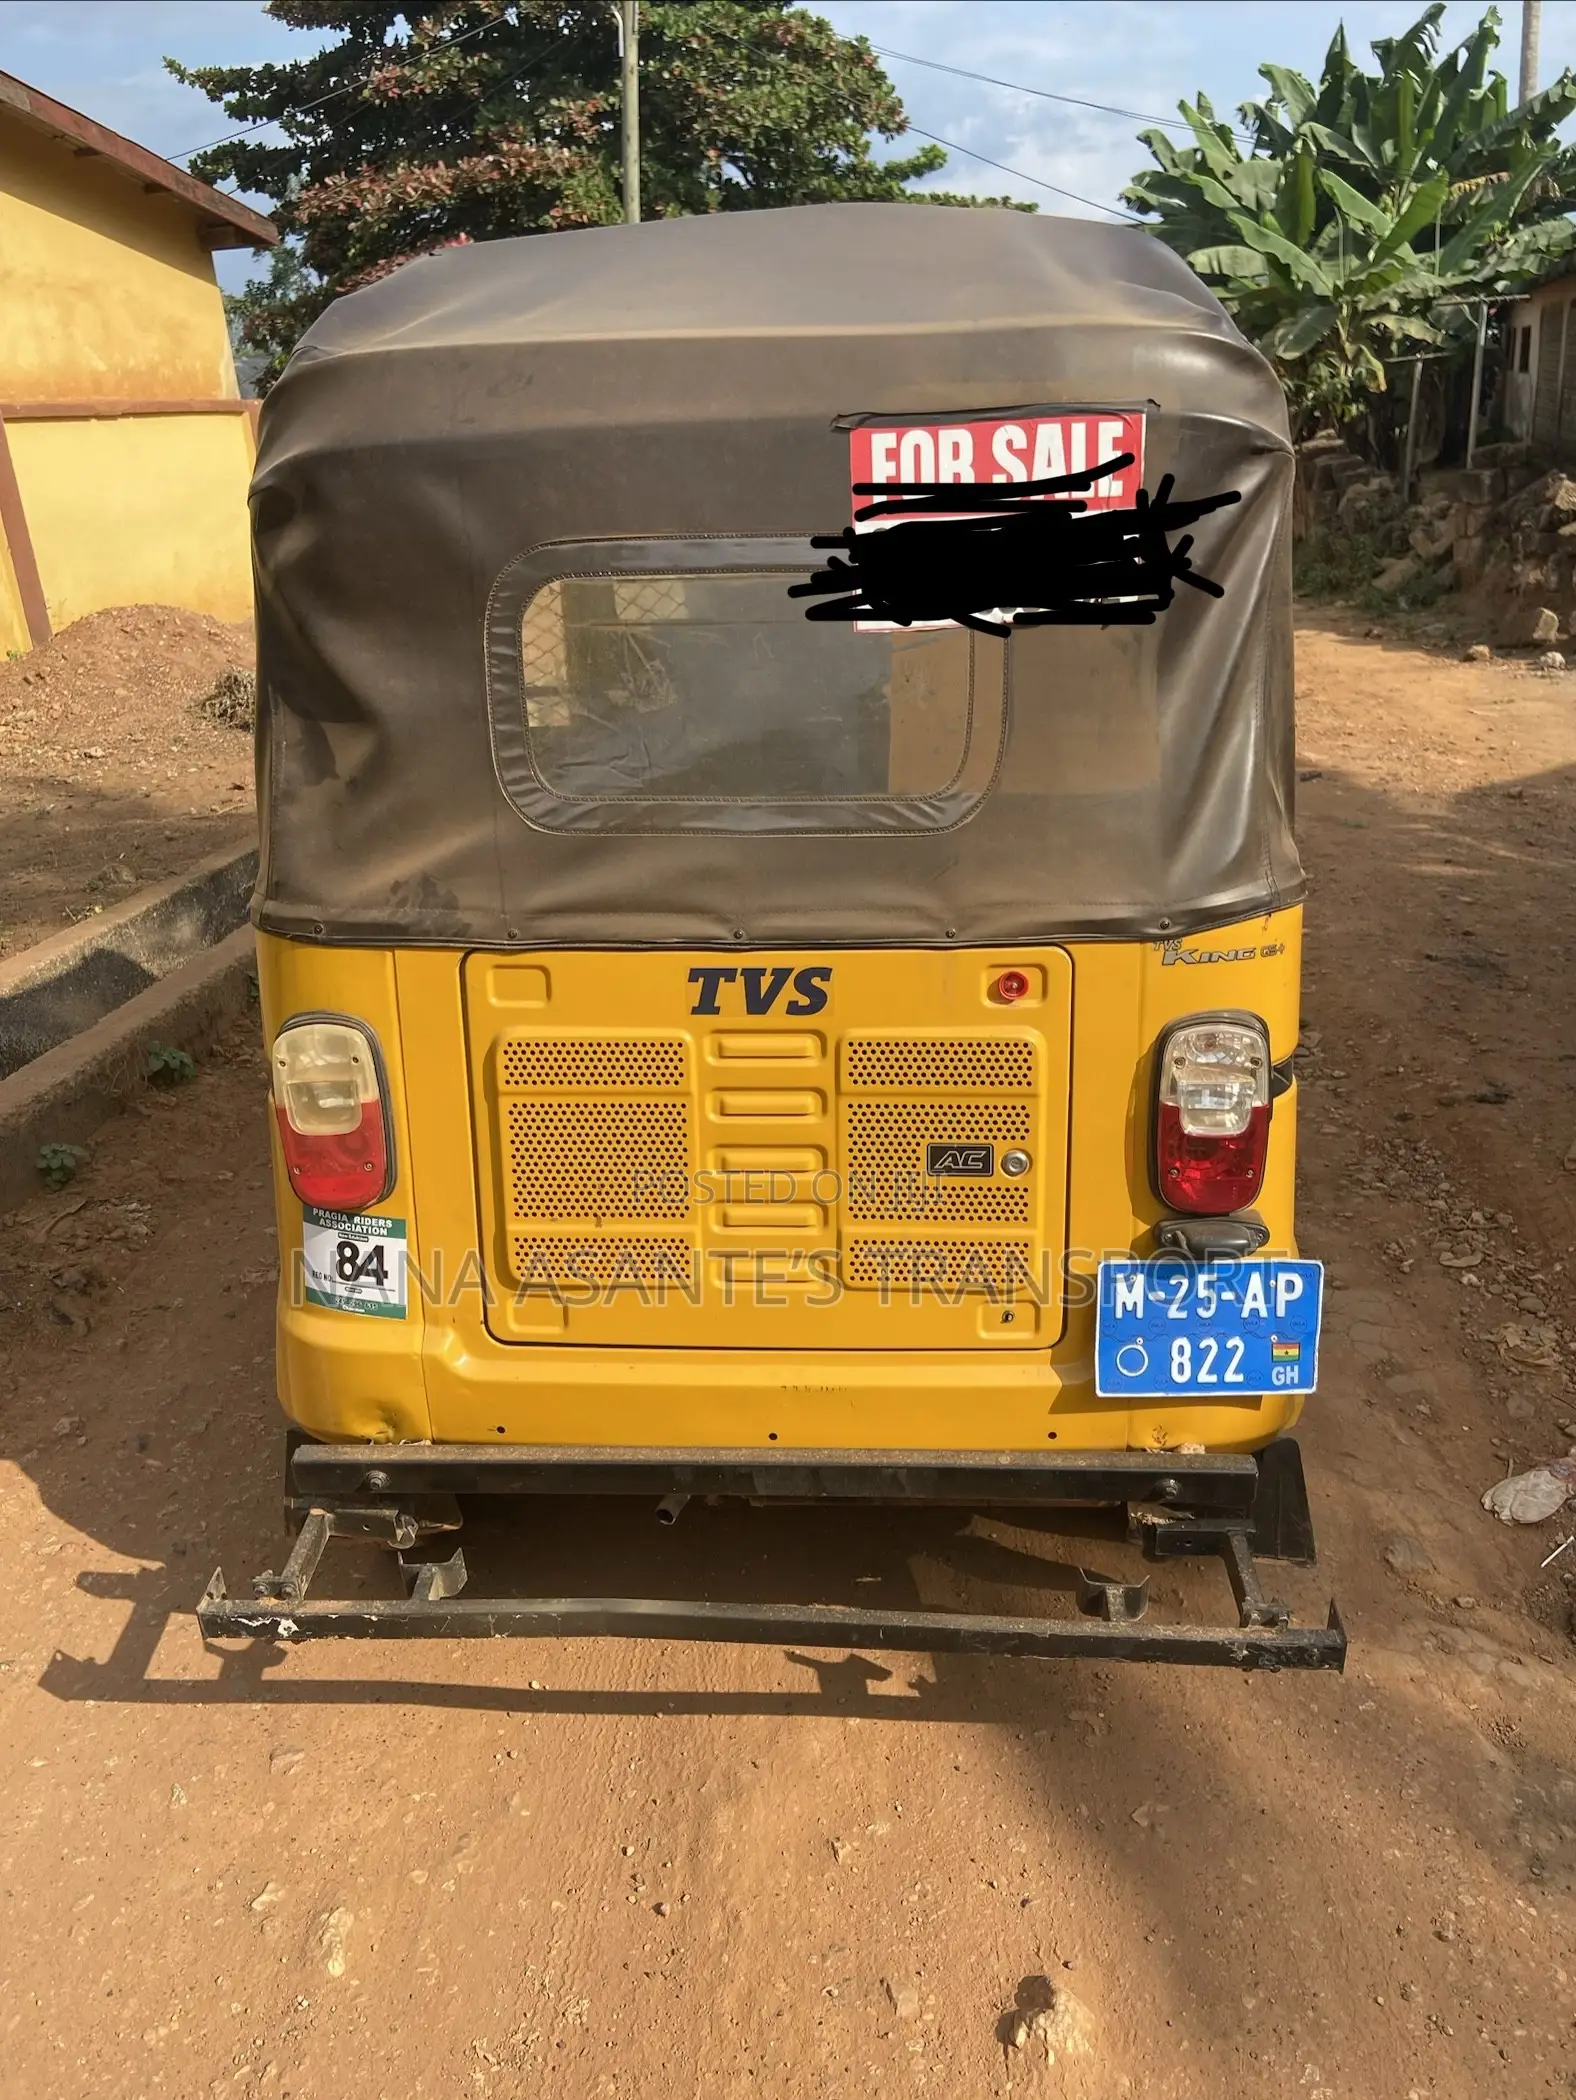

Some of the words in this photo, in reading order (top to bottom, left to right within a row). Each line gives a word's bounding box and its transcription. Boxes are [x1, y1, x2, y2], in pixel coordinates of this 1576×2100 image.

[870, 427, 975, 502] FOR
[991, 420, 1124, 499] SALE
[1152, 938, 1183, 950] TVS
[1162, 947, 1257, 966] KING
[687, 966, 833, 1016] TVS
[312, 1207, 349, 1222] PRAGIA
[353, 1216, 393, 1228] RIDERS
[319, 1218, 388, 1236] ASSOCIATION
[335, 1240, 389, 1287] 84
[1115, 1271, 1304, 1320] M-25-AP
[1170, 1336, 1245, 1384] 822
[1271, 1364, 1300, 1386] GH
